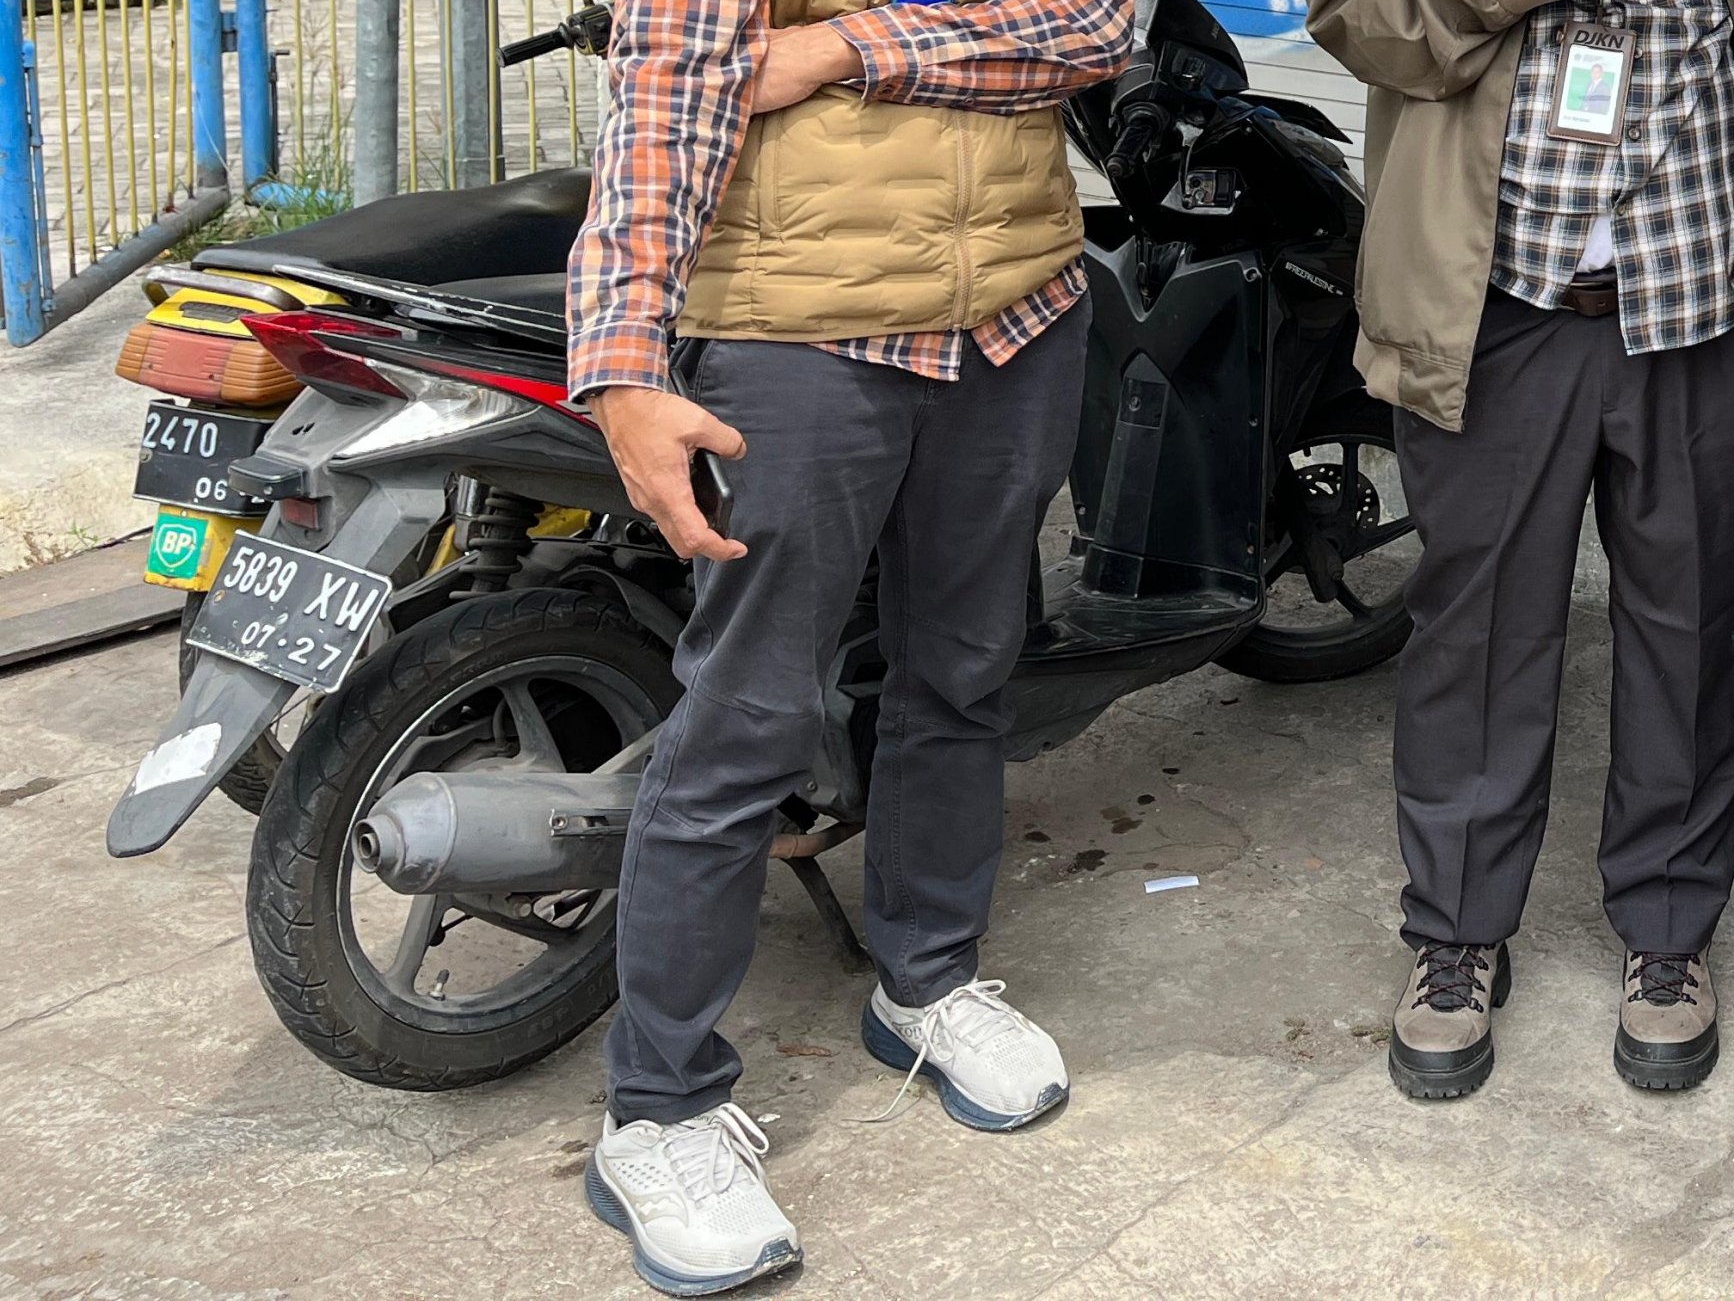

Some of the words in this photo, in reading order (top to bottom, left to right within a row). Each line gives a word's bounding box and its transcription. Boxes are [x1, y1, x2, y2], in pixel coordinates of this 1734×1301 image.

[1573, 29, 1625, 49] DJKN
[142, 413, 219, 458] 2470
[162, 530, 192, 555] BP
[223, 546, 298, 603] 5839
[304, 572, 379, 632] XW
